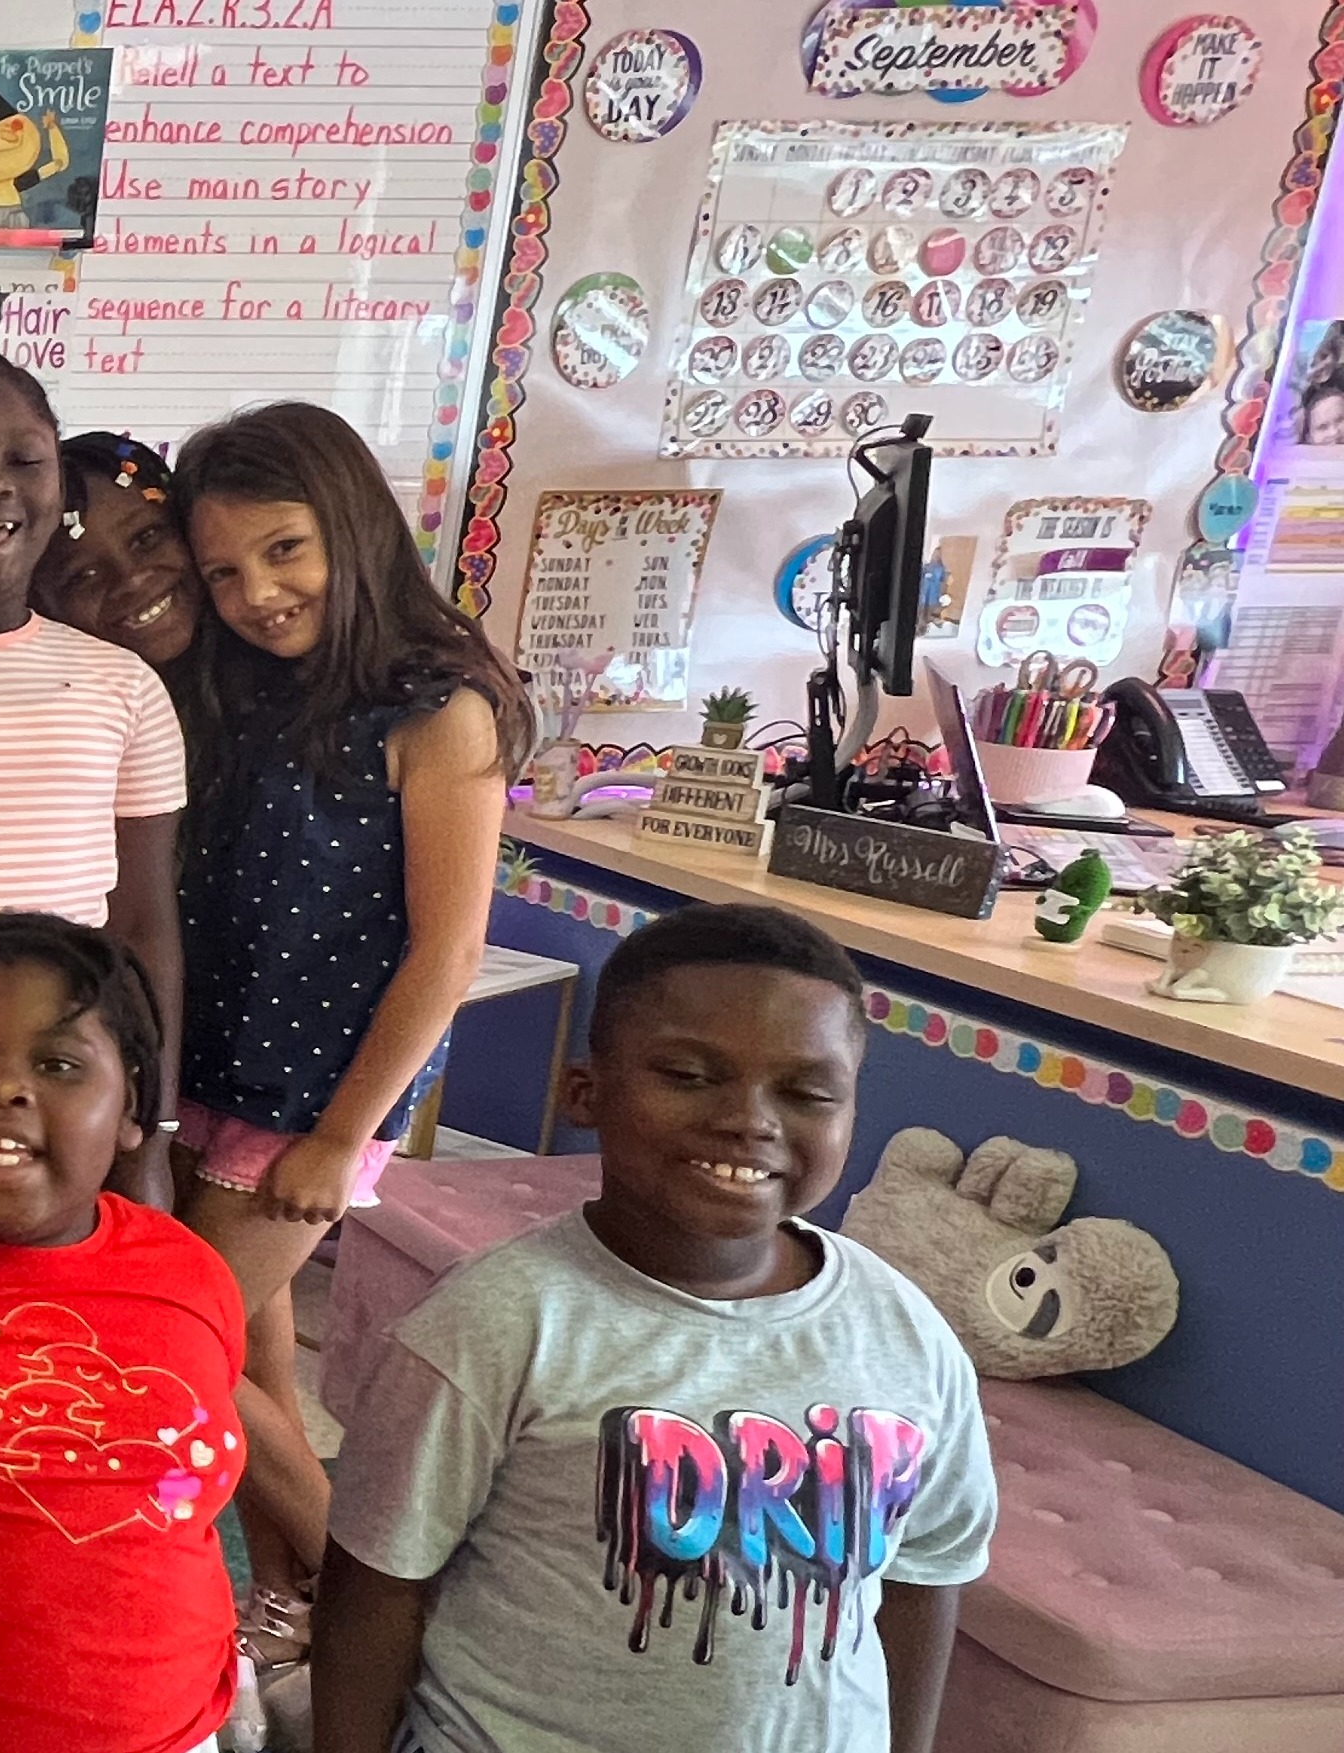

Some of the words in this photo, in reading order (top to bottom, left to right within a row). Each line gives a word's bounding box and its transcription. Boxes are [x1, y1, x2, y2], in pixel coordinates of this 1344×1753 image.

[612, 44, 667, 73] TODAY
[844, 29, 1037, 80] September
[1192, 31, 1242, 55] MAKE
[26, 55, 94, 81] Puppet's
[212, 64, 226, 87] a
[248, 45, 315, 87] text
[335, 49, 370, 86] to
[1198, 57, 1222, 80] IT
[16, 72, 102, 114] Smile
[607, 94, 661, 123] DAY
[105, 102, 222, 145] enhance
[239, 104, 453, 157] comprehension
[102, 158, 162, 200] Use
[188, 177, 260, 200] main
[271, 168, 372, 209] story
[896, 175, 921, 206] 2
[953, 178, 977, 208] 3
[1058, 177, 1085, 207] 5
[92, 218, 227, 254] elements
[250, 233, 279, 254] in
[299, 233, 317, 254] a
[337, 218, 438, 260] logical
[1037, 235, 1070, 261] 12
[5, 296, 71, 336] Hair
[87, 296, 205, 335] sequence
[222, 280, 272, 320] for
[286, 299, 303, 320] a
[323, 283, 432, 325] literary
[713, 288, 741, 317] 13
[765, 287, 792, 317] 14
[871, 289, 904, 318] 16
[978, 286, 1006, 317] 18
[1028, 289, 1058, 317] 19
[3, 338, 65, 369] Love
[84, 338, 145, 374] text
[744, 396, 780, 428] 28
[797, 399, 832, 427] 29
[847, 401, 880, 428] 30
[552, 510, 610, 554] Days
[634, 509, 691, 535] Week
[540, 557, 592, 573] SUNDAY
[535, 576, 590, 592] MONDAY
[534, 596, 590, 611] TUESDAY
[530, 614, 607, 630] WEDNESDAY
[529, 633, 594, 648] THURSDAY
[525, 653, 561, 668] FRIDA
[662, 783, 746, 813] DIFFERENT
[641, 816, 671, 835] FOR
[673, 821, 756, 848] EVERYONE
[792, 824, 849, 866] Mrs
[854, 835, 965, 888] Russell
